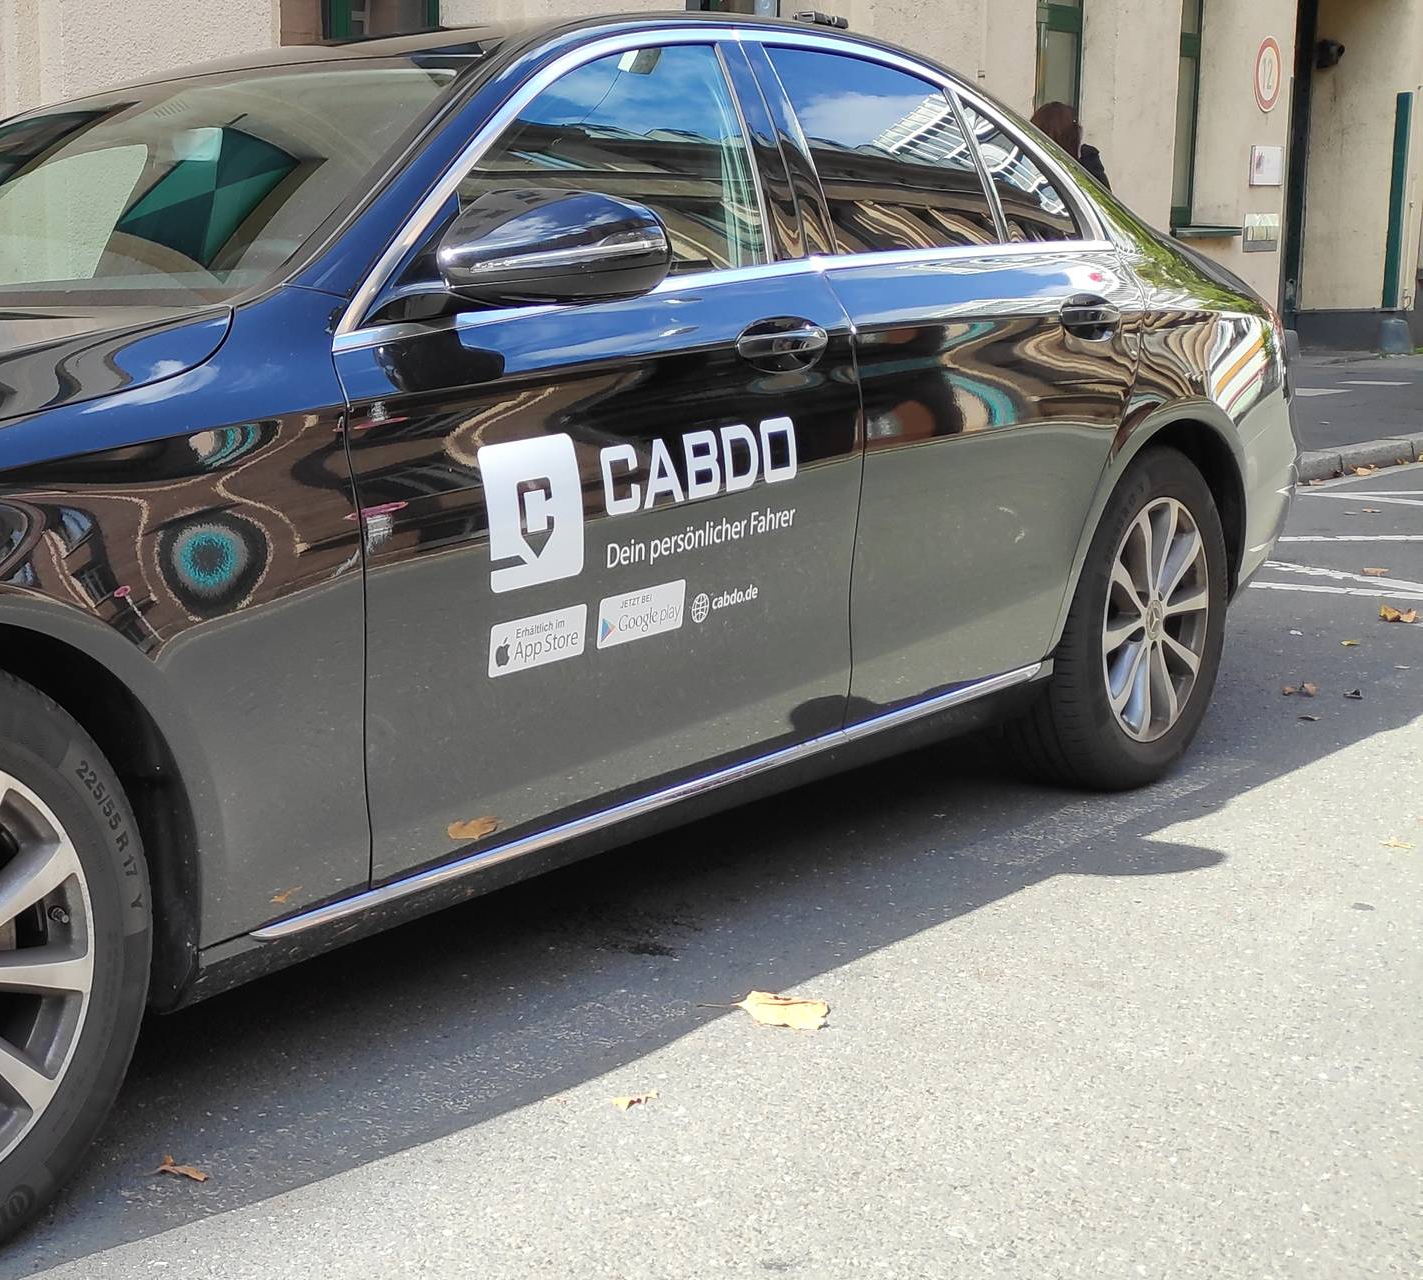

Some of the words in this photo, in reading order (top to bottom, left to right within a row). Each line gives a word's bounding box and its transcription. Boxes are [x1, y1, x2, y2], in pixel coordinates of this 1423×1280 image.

[599, 416, 797, 516] CABDO
[606, 540, 646, 569] Dein
[650, 517, 750, 565] persönlicher
[750, 507, 796, 536] Fahrer
[620, 595, 641, 609] JETZT
[641, 594, 653, 604] BEI
[711, 584, 759, 610] cabdo.de
[516, 622, 554, 639] Erhältlich
[556, 619, 565, 629] im
[618, 607, 658, 632] Google
[660, 604, 681, 625] play
[514, 641, 543, 663] App
[544, 632, 579, 653] Store
[76, 760, 122, 831] 225/55
[115, 831, 130, 853] R
[123, 854, 138, 877] 17
